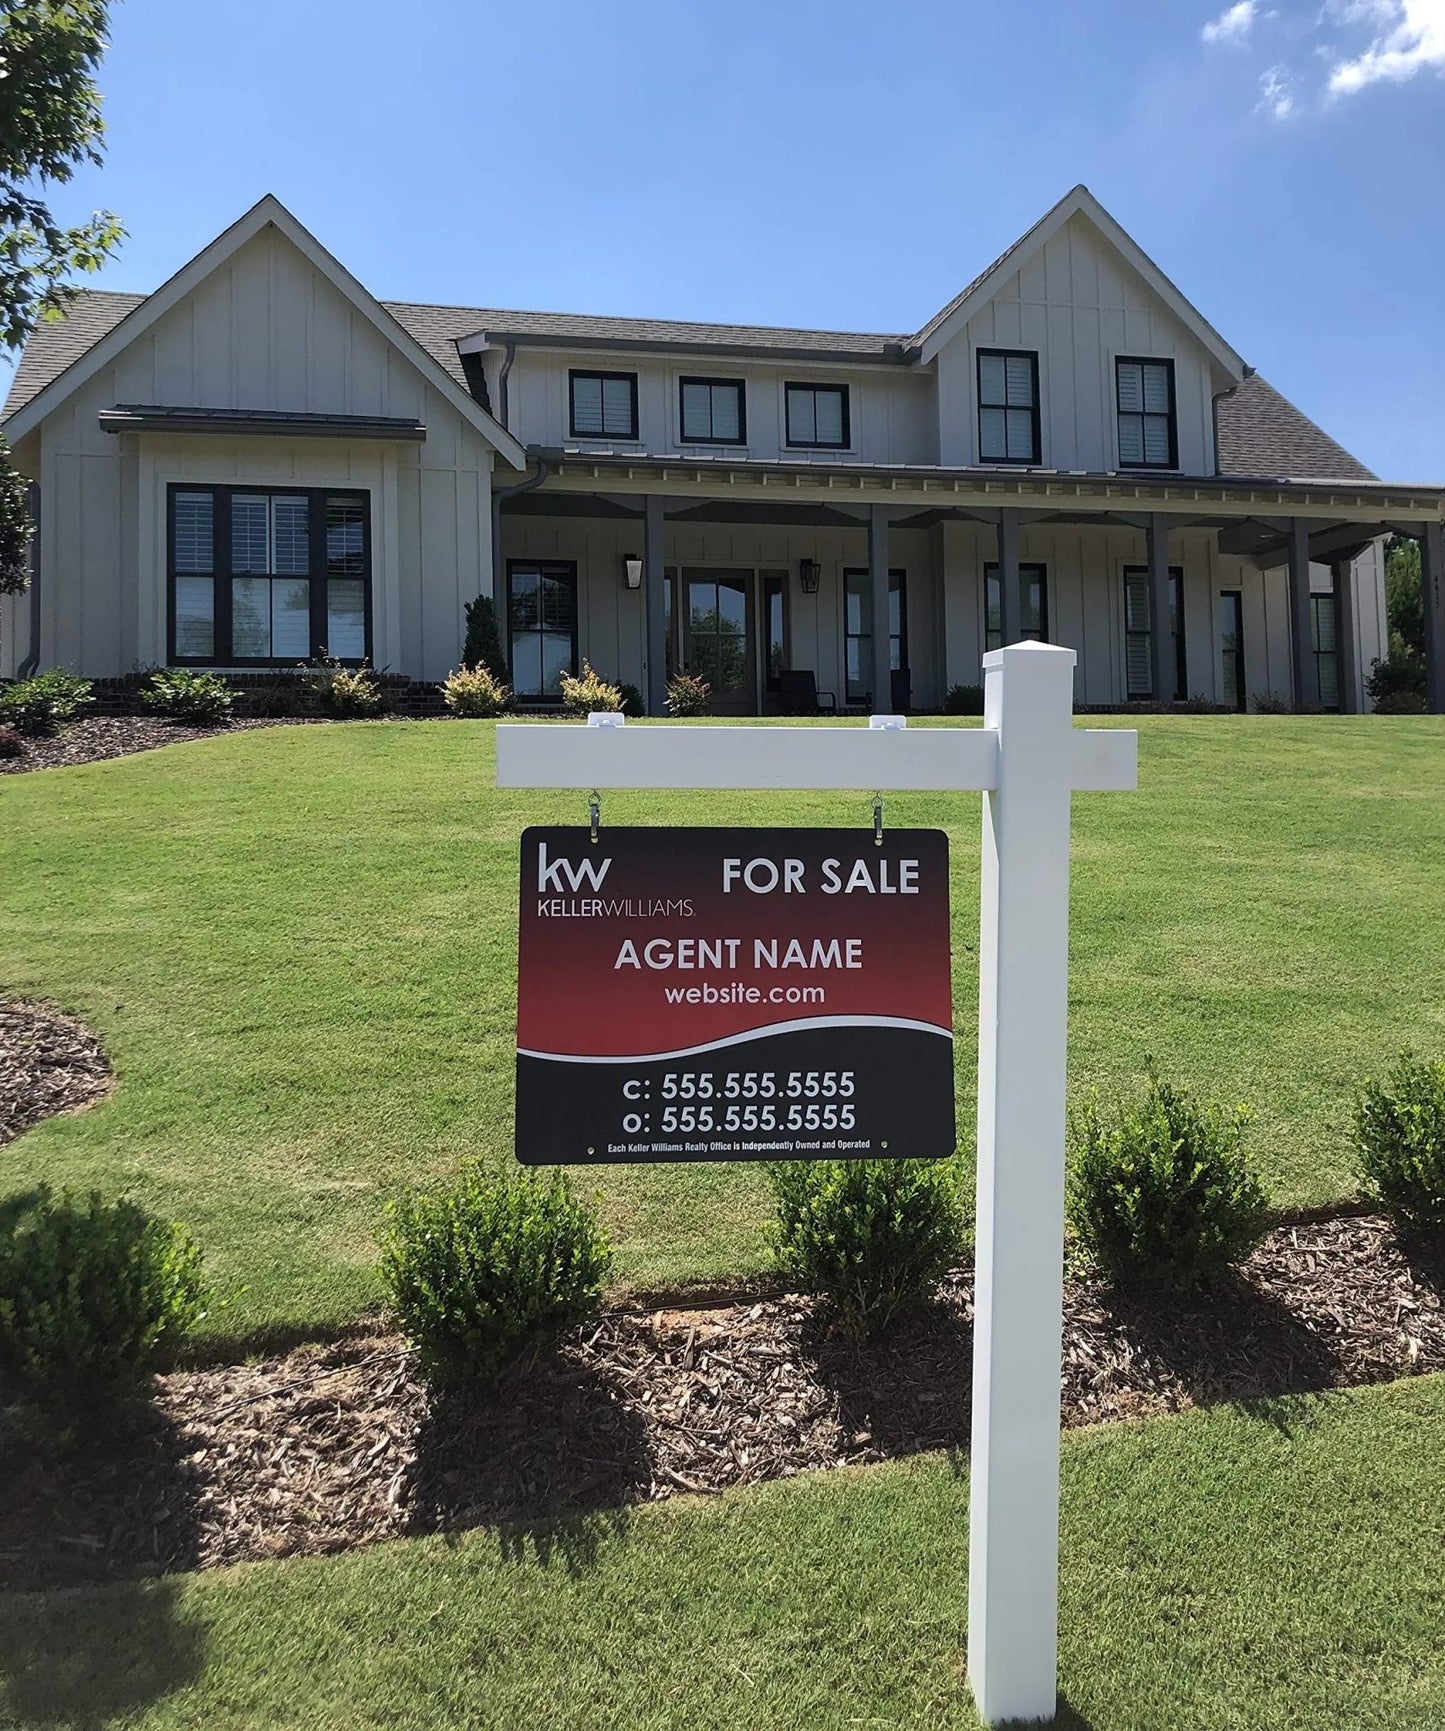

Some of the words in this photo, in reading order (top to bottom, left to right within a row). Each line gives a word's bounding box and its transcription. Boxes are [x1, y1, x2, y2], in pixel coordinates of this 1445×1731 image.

[539, 842, 611, 892] kw
[724, 858, 805, 893] FOR
[821, 859, 918, 893] SALE
[614, 939, 740, 969] AGENT
[755, 939, 861, 968] NAME
[665, 983, 824, 1003] website.com
[623, 1080, 649, 1099] c:
[662, 1072, 854, 1099] 555.555.5555
[623, 1114, 649, 1132] o:
[662, 1105, 855, 1132] 555.555.5555
[608, 1143, 626, 1153] Each
[628, 1143, 649, 1153] Keller
[652, 1142, 683, 1152] Williams
[685, 1142, 708, 1152] Realty
[710, 1141, 731, 1151] Office
[734, 1141, 740, 1151] is
[742, 1140, 793, 1151] Independently
[796, 1140, 820, 1150] Owned
[822, 1139, 835, 1149] and
[838, 1139, 870, 1150] Operated
